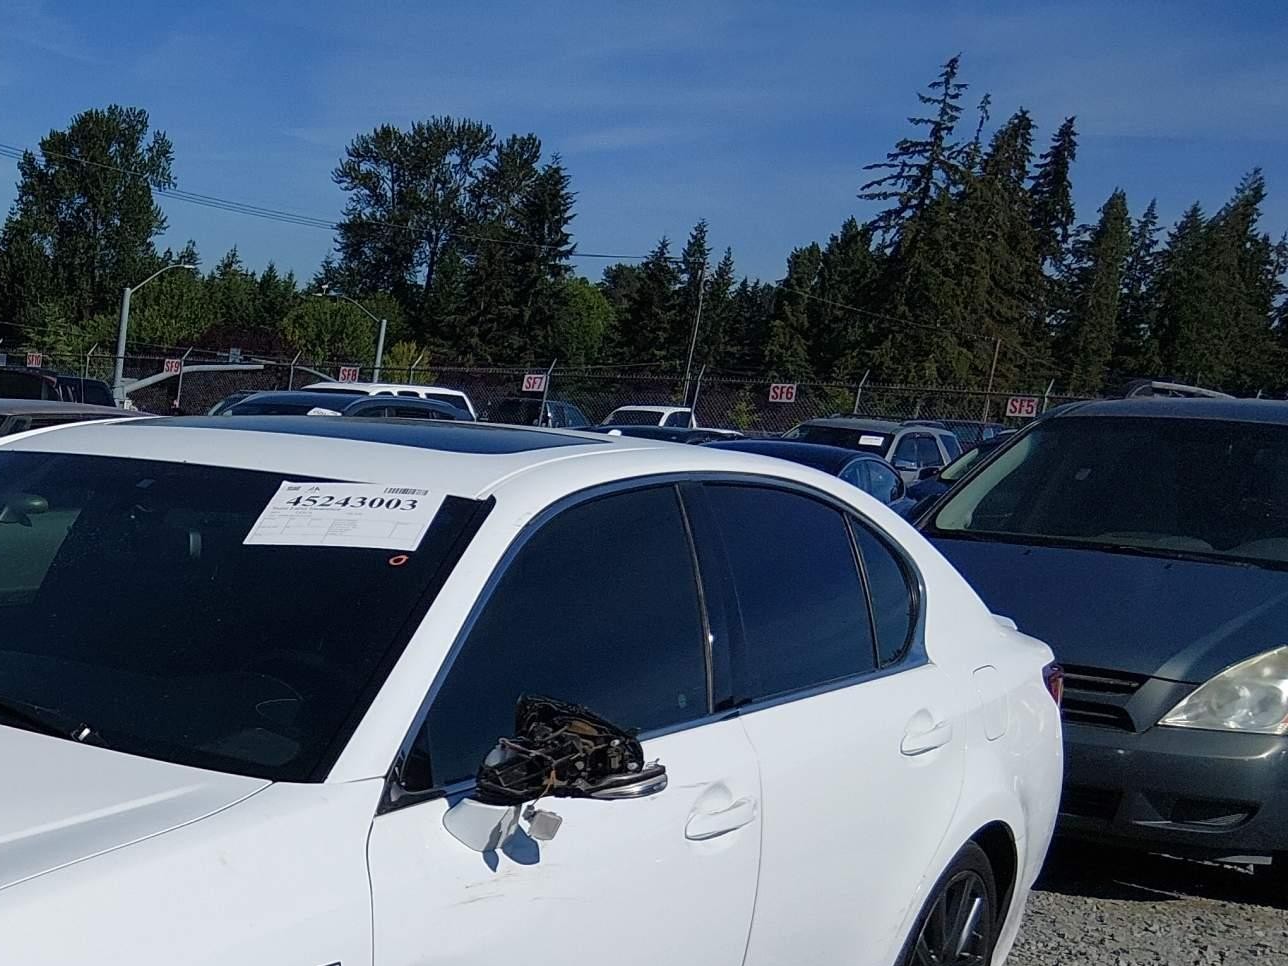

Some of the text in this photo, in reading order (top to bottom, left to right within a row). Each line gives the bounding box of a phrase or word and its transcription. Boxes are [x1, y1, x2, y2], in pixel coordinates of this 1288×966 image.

[165, 360, 180, 372] SF9
[341, 368, 358, 381] SF8
[525, 376, 544, 389] SF7
[771, 385, 794, 400] SF6
[1009, 399, 1035, 415] SF5
[286, 495, 418, 511] 45243003
